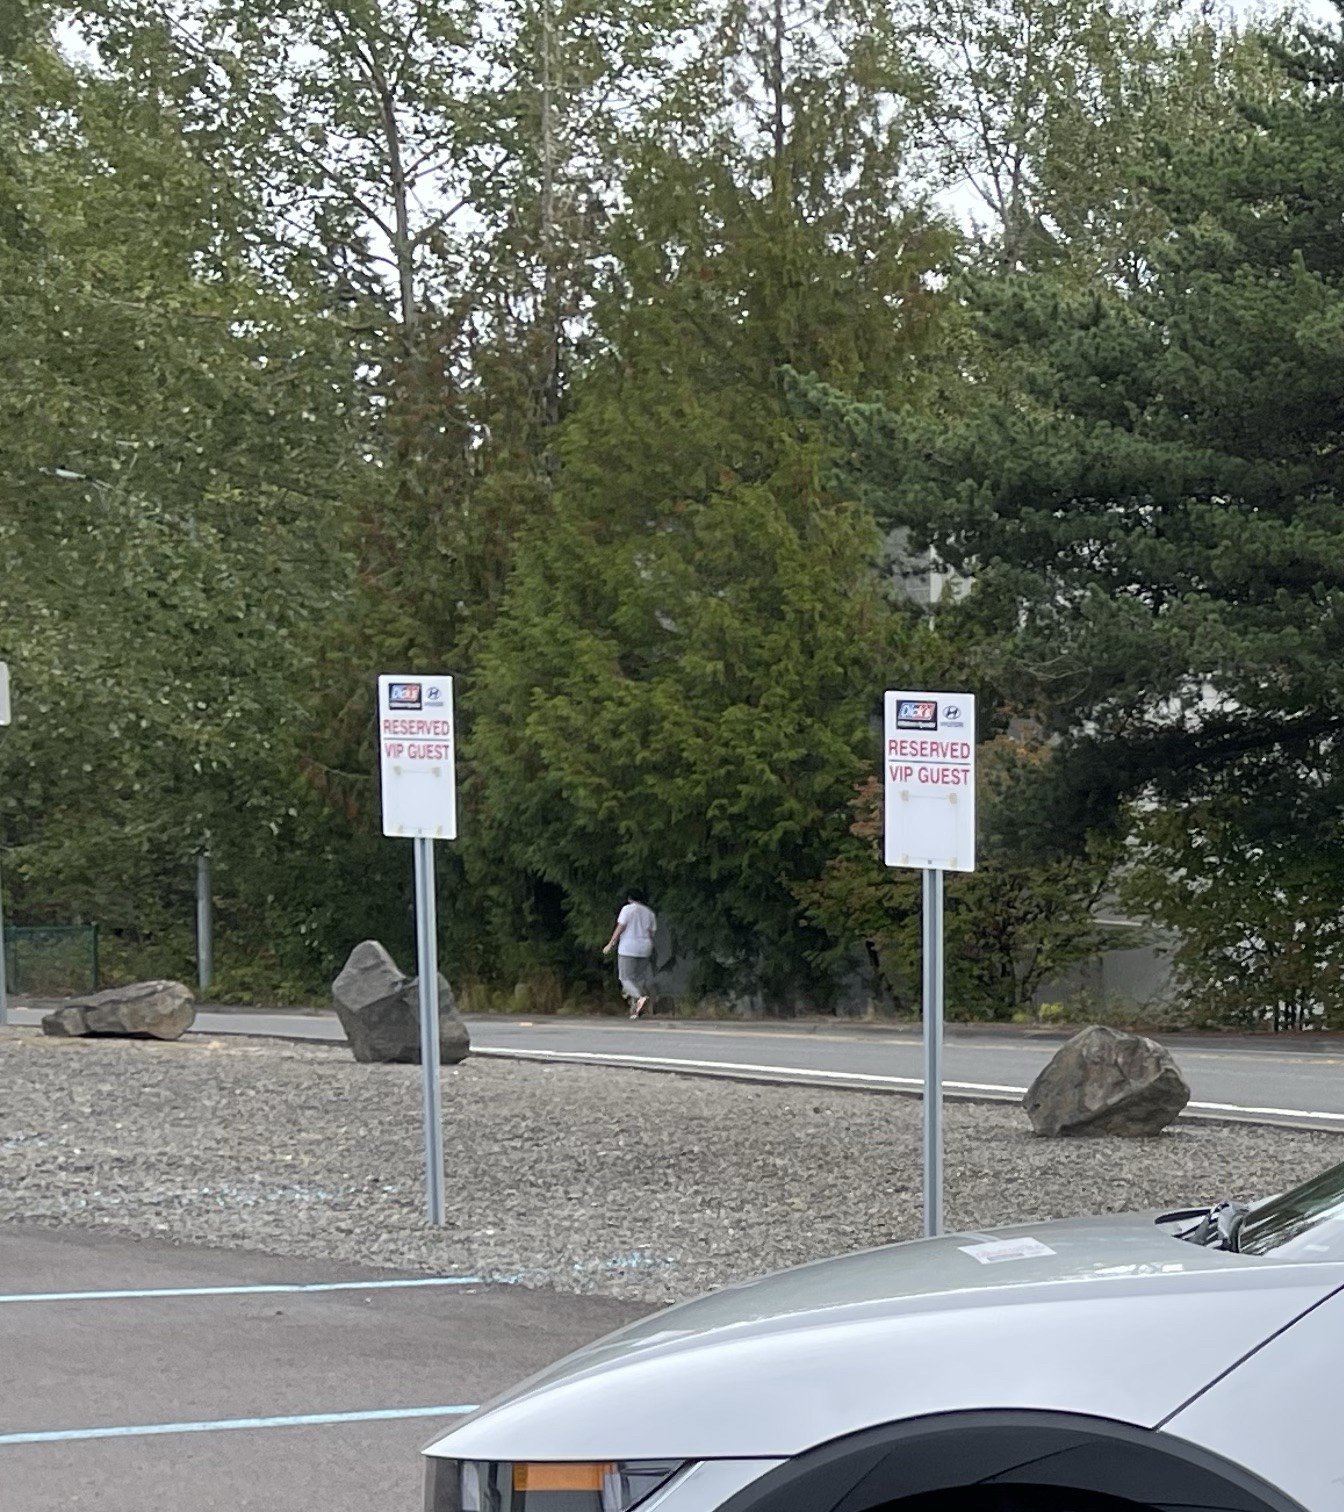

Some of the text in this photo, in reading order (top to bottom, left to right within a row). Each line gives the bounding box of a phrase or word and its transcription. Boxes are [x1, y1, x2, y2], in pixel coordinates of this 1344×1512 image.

[383, 719, 450, 737] RESERVED
[384, 743, 450, 761] VIP GUEST
[888, 739, 971, 760] RESERVED
[889, 765, 971, 785] VIP GUEST
